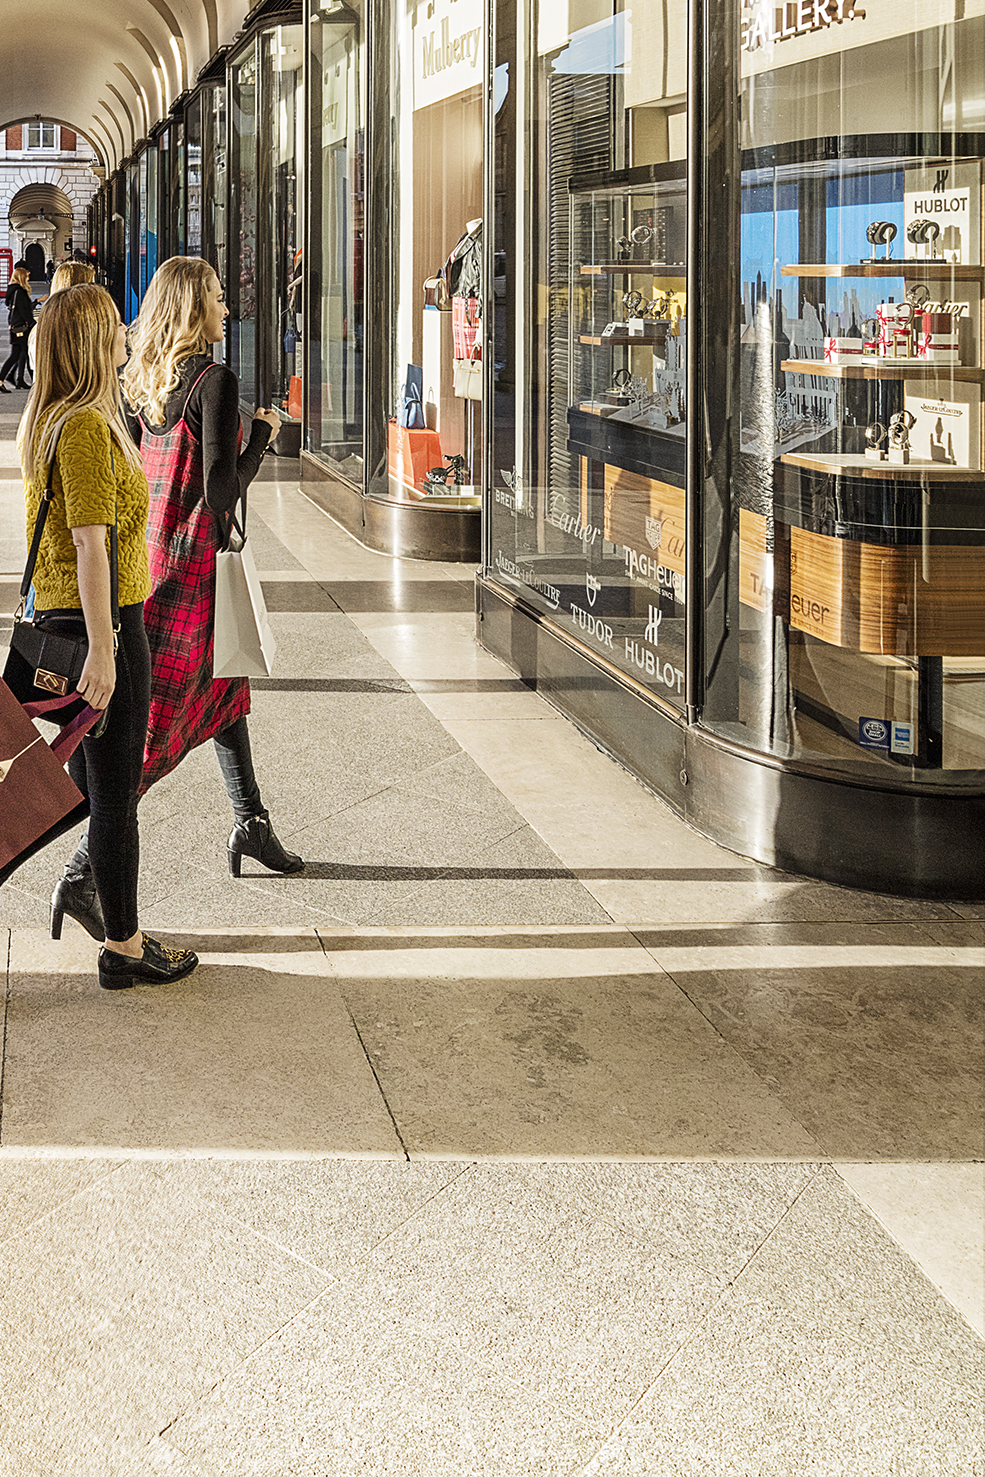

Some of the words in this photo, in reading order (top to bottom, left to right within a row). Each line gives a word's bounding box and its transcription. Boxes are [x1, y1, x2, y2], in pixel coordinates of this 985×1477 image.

[421, 15, 482, 80] Mulberry
[914, 197, 968, 214] HUBLOT
[924, 299, 968, 317] artier
[551, 494, 601, 544] Cartier
[570, 603, 614, 649] TUDOR
[624, 637, 684, 694] HUBLOT
